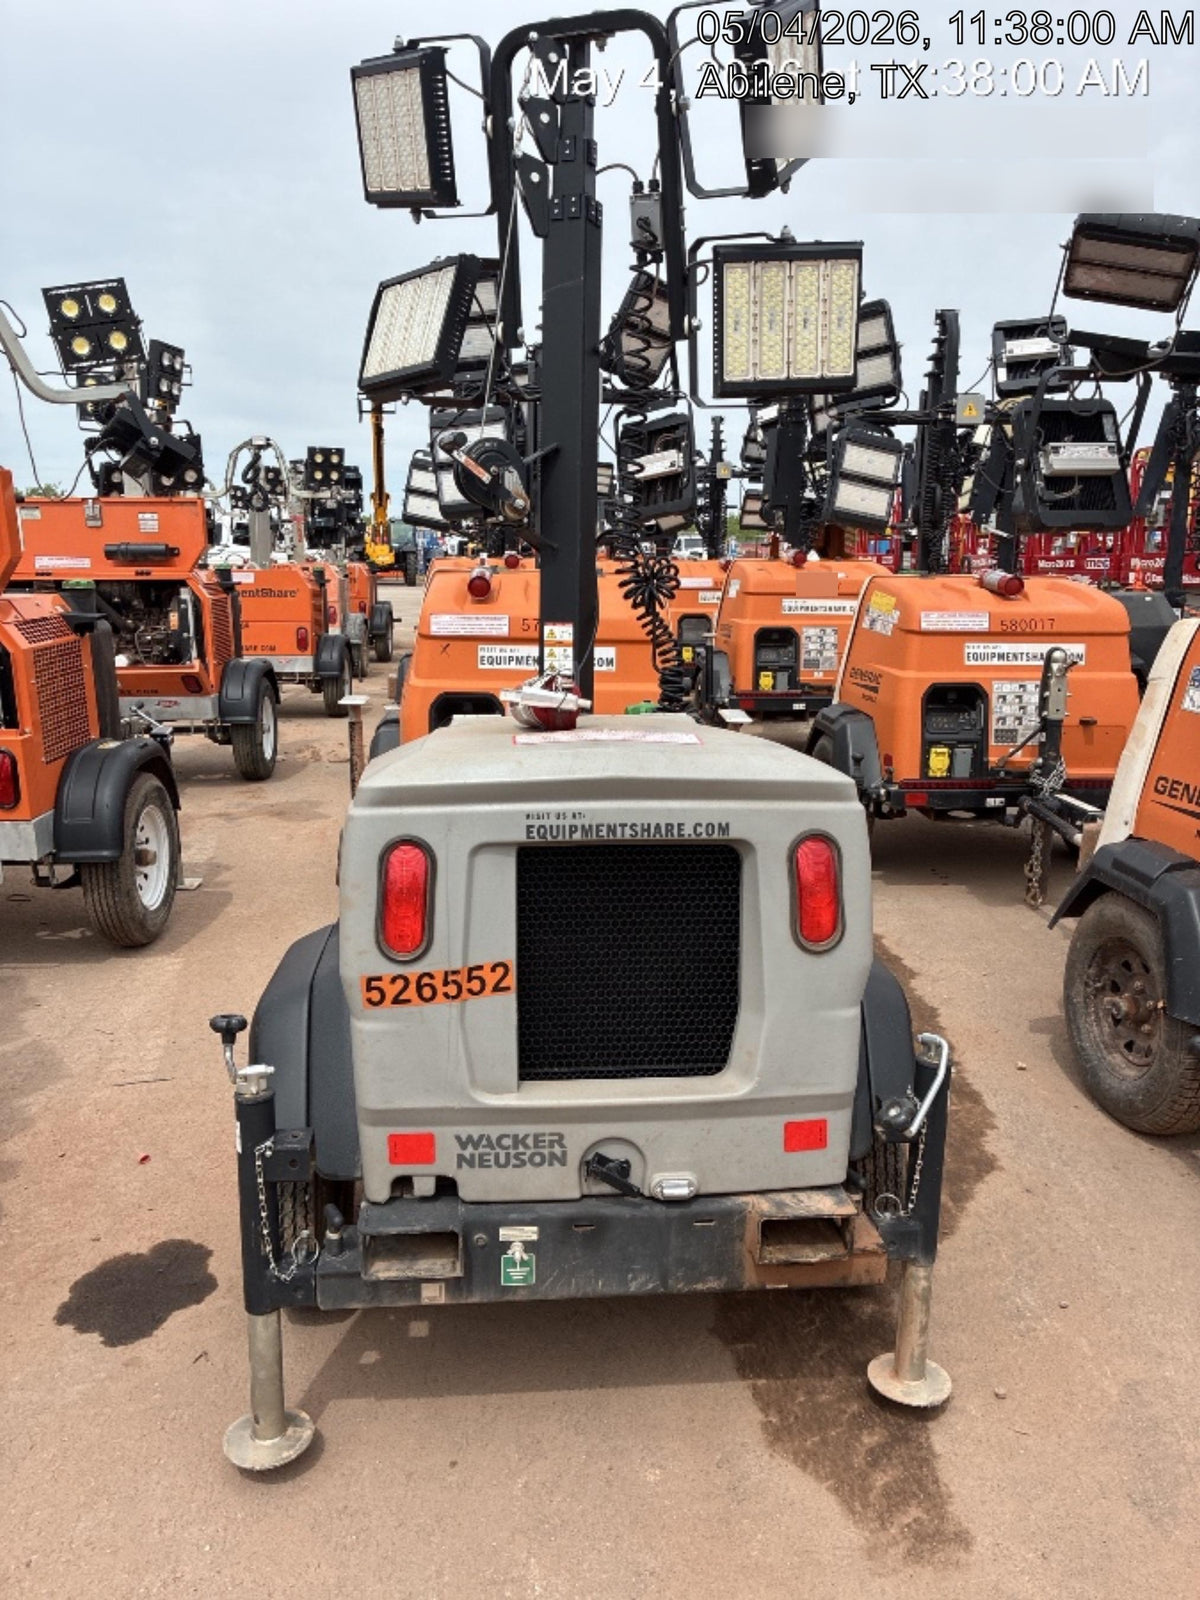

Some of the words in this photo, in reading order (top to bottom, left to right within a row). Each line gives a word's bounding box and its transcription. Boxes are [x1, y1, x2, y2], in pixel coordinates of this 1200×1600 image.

[1000, 618, 1066, 632] 580017
[526, 822, 730, 840] EQUIPMENTSHARE.COM
[365, 961, 512, 1007] 526552
[454, 1132, 567, 1151] WACKER
[456, 1150, 568, 1169] NEUSON
